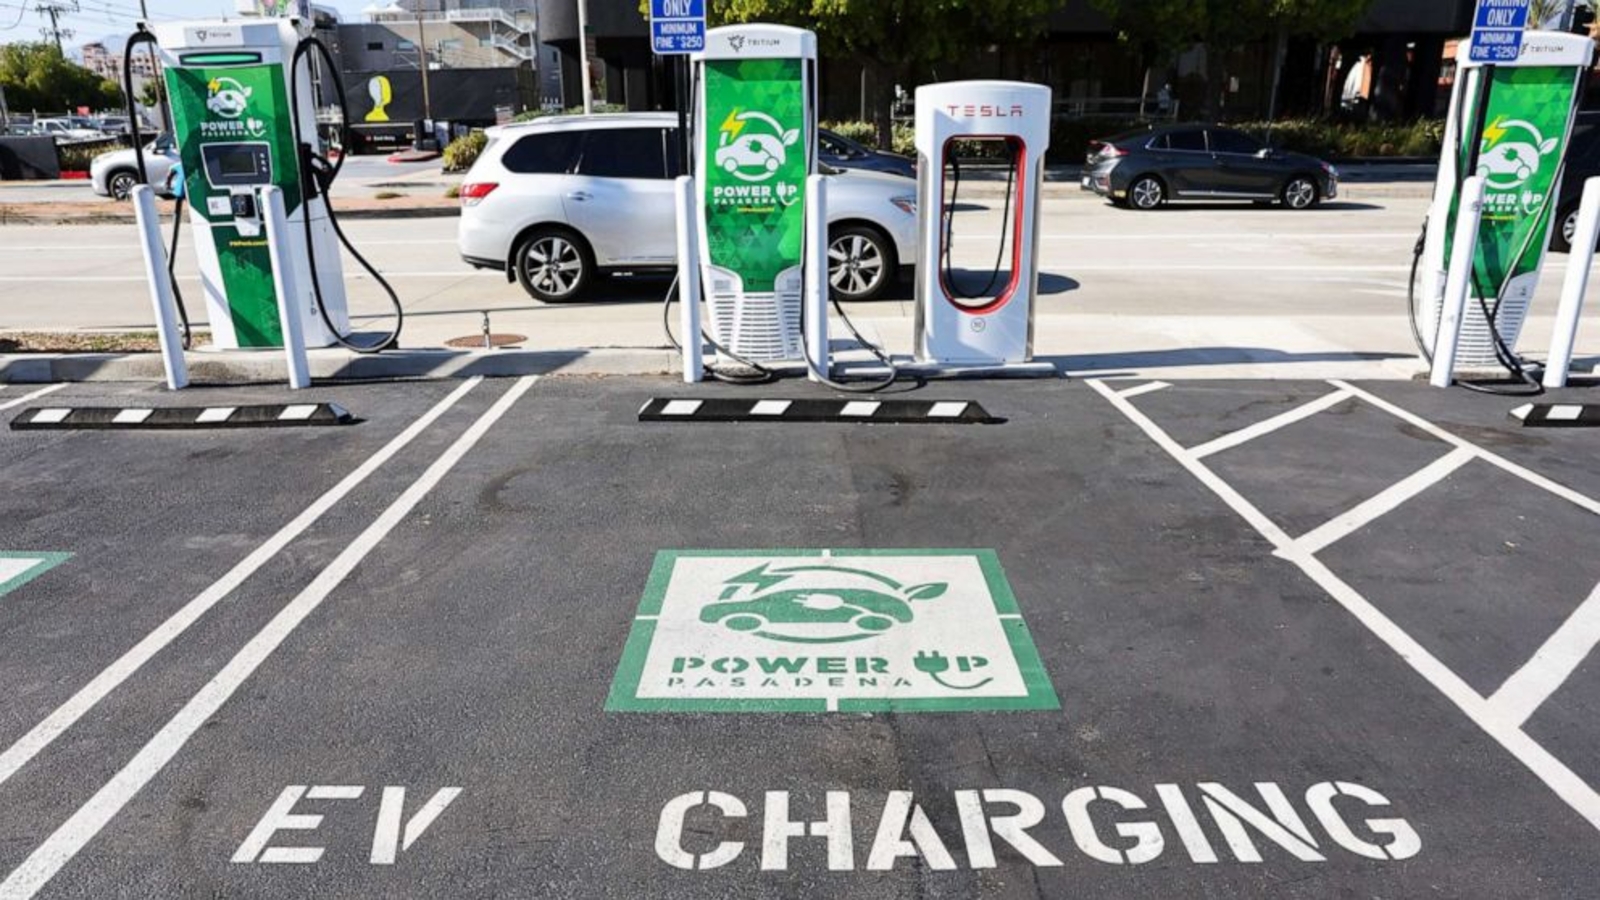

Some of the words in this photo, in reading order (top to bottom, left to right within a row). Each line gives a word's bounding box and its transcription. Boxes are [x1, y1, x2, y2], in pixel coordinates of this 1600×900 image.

[663, 0, 691, 16] ONLY
[1487, 8, 1517, 26] ONLY
[660, 22, 697, 35] MINIMUM
[656, 36, 674, 48] FINE
[1479, 32, 1515, 44] MINIMUM
[1471, 45, 1490, 58] FINE
[947, 105, 1023, 117] TESLA
[201, 121, 244, 131] POWER
[713, 186, 771, 197] POWER
[671, 656, 889, 674] POWER
[667, 676, 912, 688] PASADENA
[230, 785, 463, 864] EV
[654, 781, 1423, 871] CHARGING
